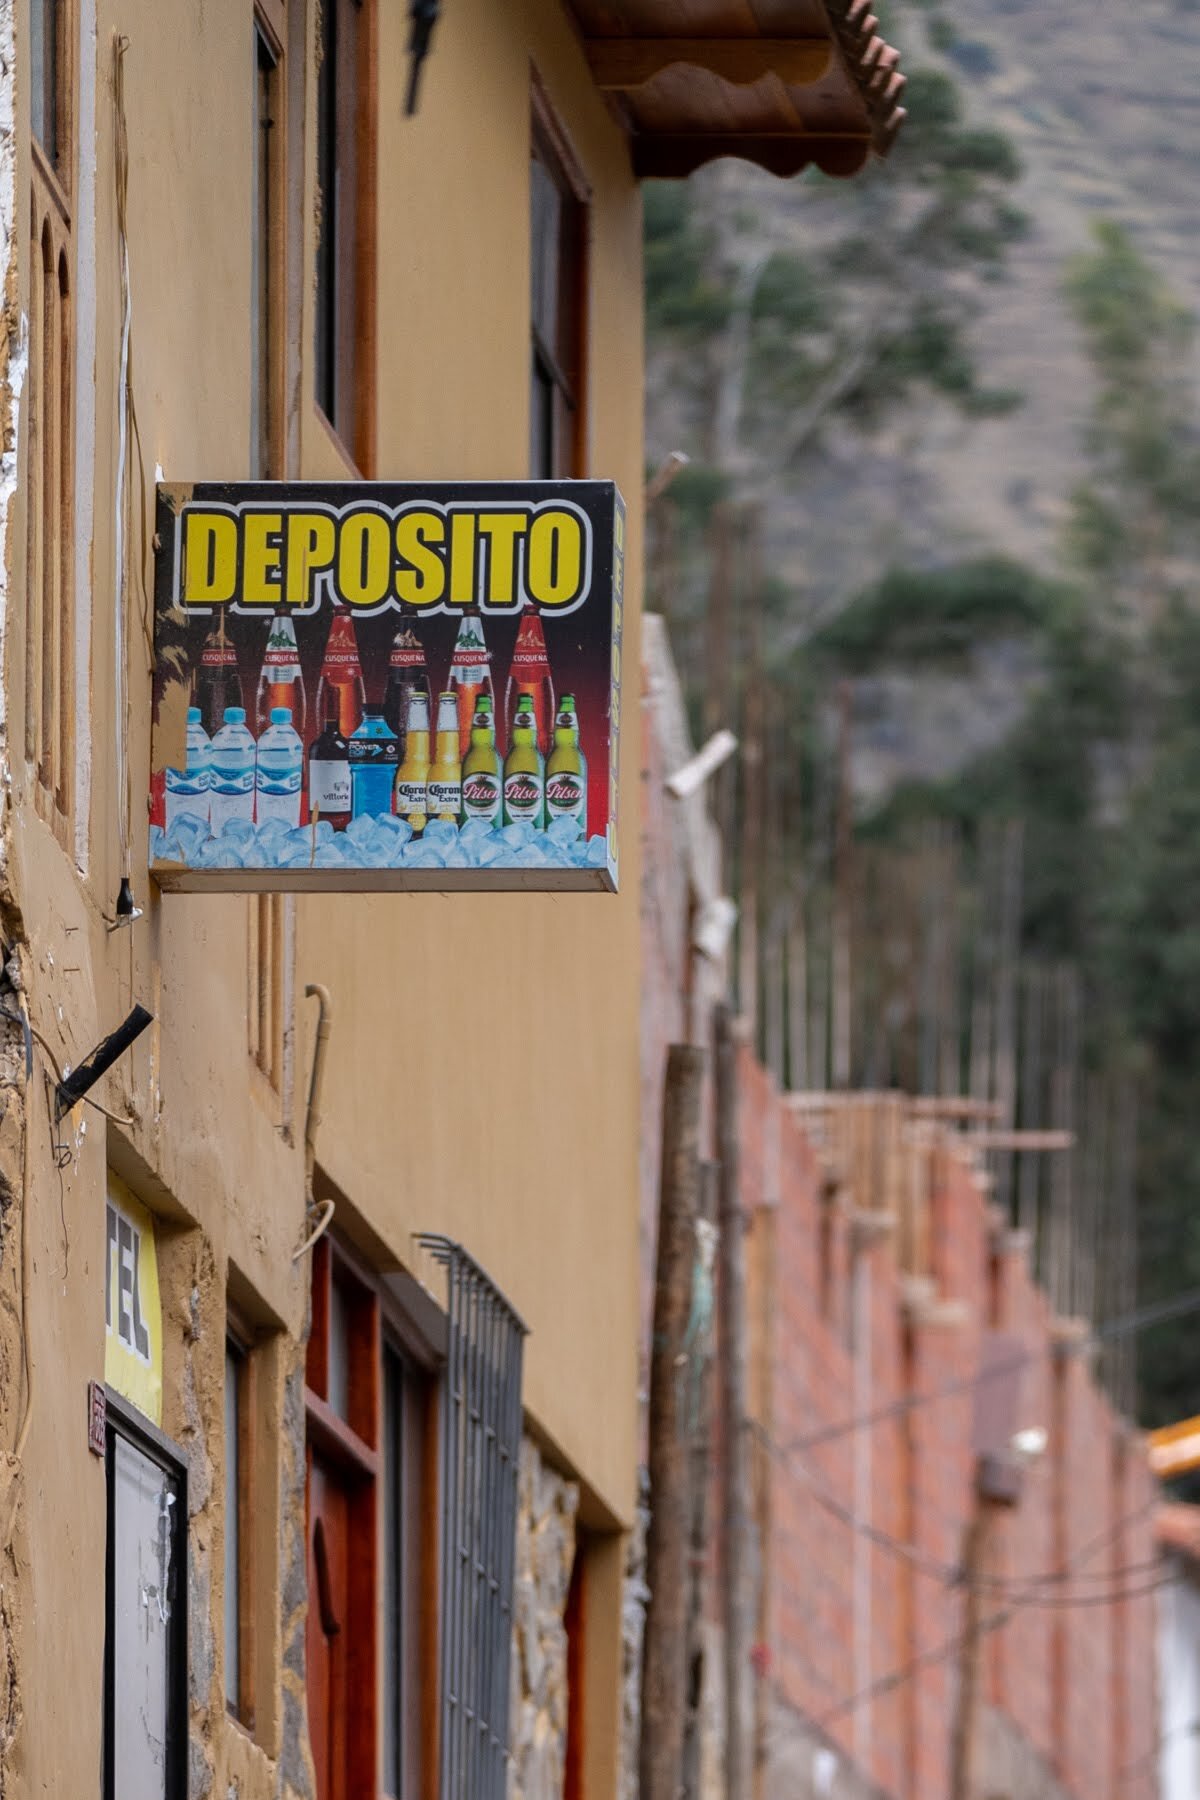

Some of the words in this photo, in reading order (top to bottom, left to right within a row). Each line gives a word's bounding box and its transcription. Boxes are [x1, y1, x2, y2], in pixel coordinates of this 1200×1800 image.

[185, 511, 583, 604] DEPOSITO
[326, 653, 359, 664] CUSQUEÑA
[391, 653, 425, 664] CUSQUEÑA
[514, 653, 548, 664] CUSQUEÑA
[463, 783, 500, 800] Pilsen
[504, 783, 541, 800] Pilsen
[546, 783, 583, 800] Pilsen
